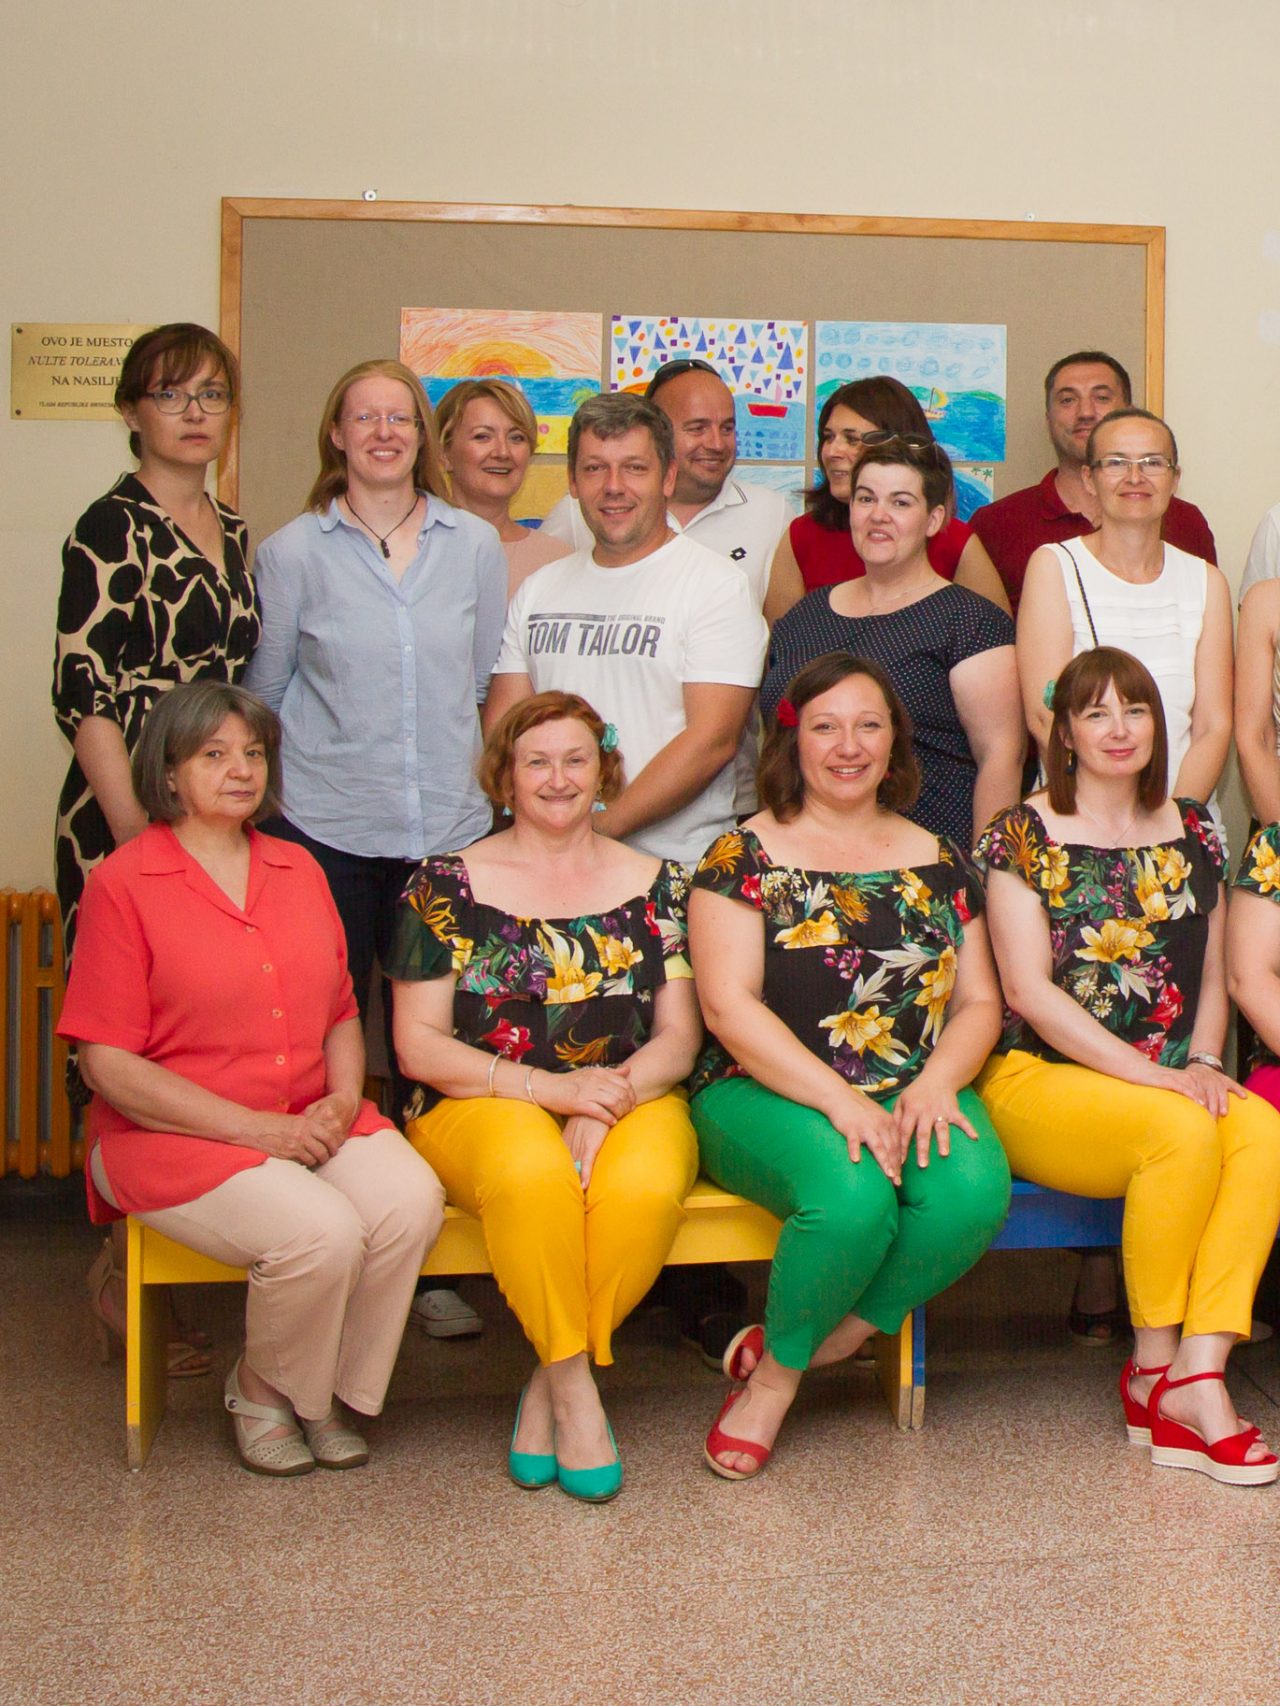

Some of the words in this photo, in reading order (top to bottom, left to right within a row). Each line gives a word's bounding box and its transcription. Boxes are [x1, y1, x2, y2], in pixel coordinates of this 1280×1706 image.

[41, 337, 67, 347] OVO
[69, 337, 83, 347] JE
[86, 337, 133, 347] MJESTO
[28, 356, 67, 366] NULTE
[69, 356, 121, 366] TOLERAN
[51, 376, 70, 386] NA
[528, 622, 572, 656] TOM
[578, 623, 661, 657] TAILOR
